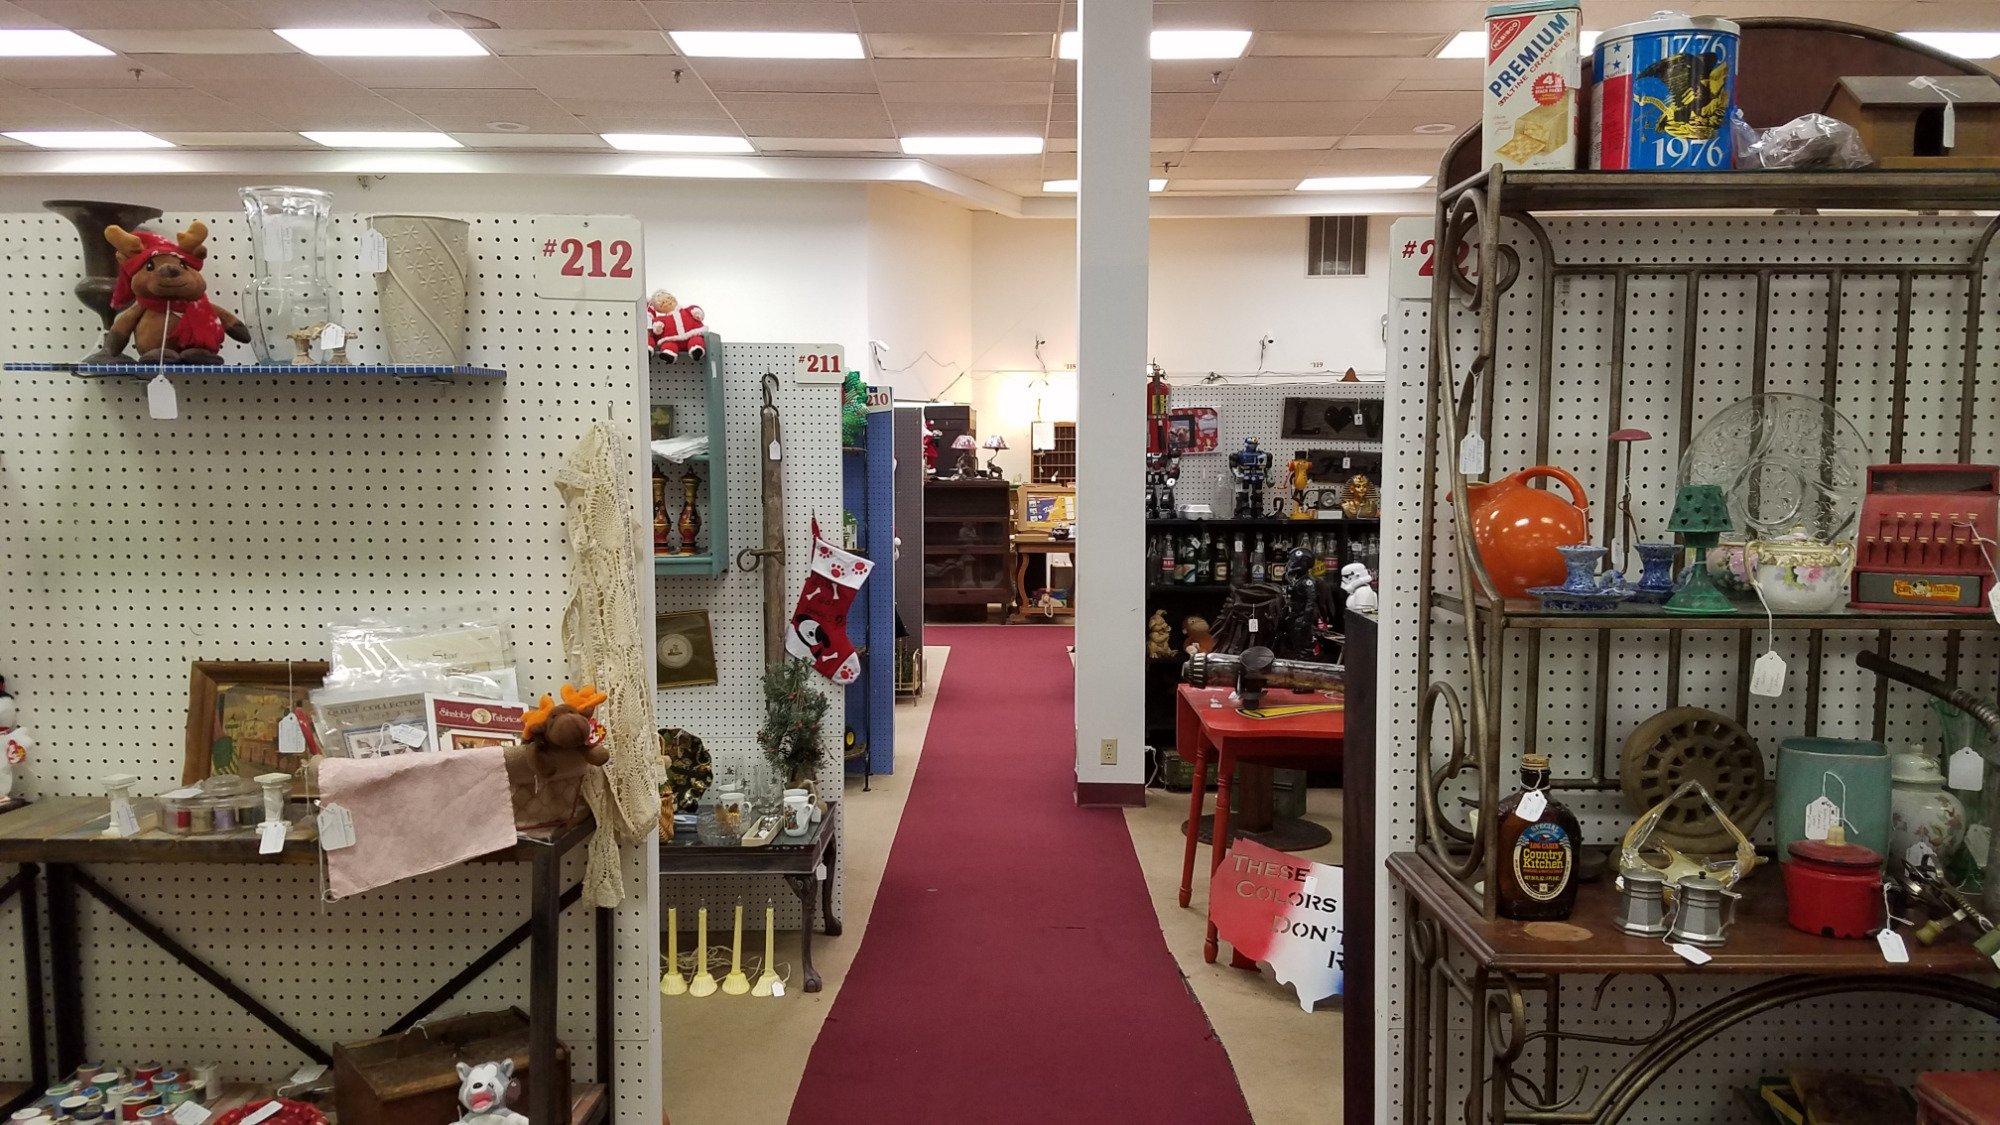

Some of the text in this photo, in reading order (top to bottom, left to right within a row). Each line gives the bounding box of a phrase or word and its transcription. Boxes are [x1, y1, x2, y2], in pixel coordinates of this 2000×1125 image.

[1492, 21, 1518, 49] NABISCO
[1658, 35, 1726, 63] 1776
[1489, 13, 1569, 98] PREMIUM
[1498, 74, 1529, 107] SALTINE
[1529, 31, 1571, 73] CRACKERS
[1542, 75, 1553, 85] 4
[1652, 137, 1722, 167] 1976
[543, 239, 633, 278] #212
[798, 354, 841, 373] #211
[362, 699, 423, 711] COLLECTIO
[1232, 853, 1310, 882] THESE
[1523, 848, 1564, 860] Country
[1523, 858, 1564, 869] Kitchen
[1236, 880, 1337, 913] COLORS
